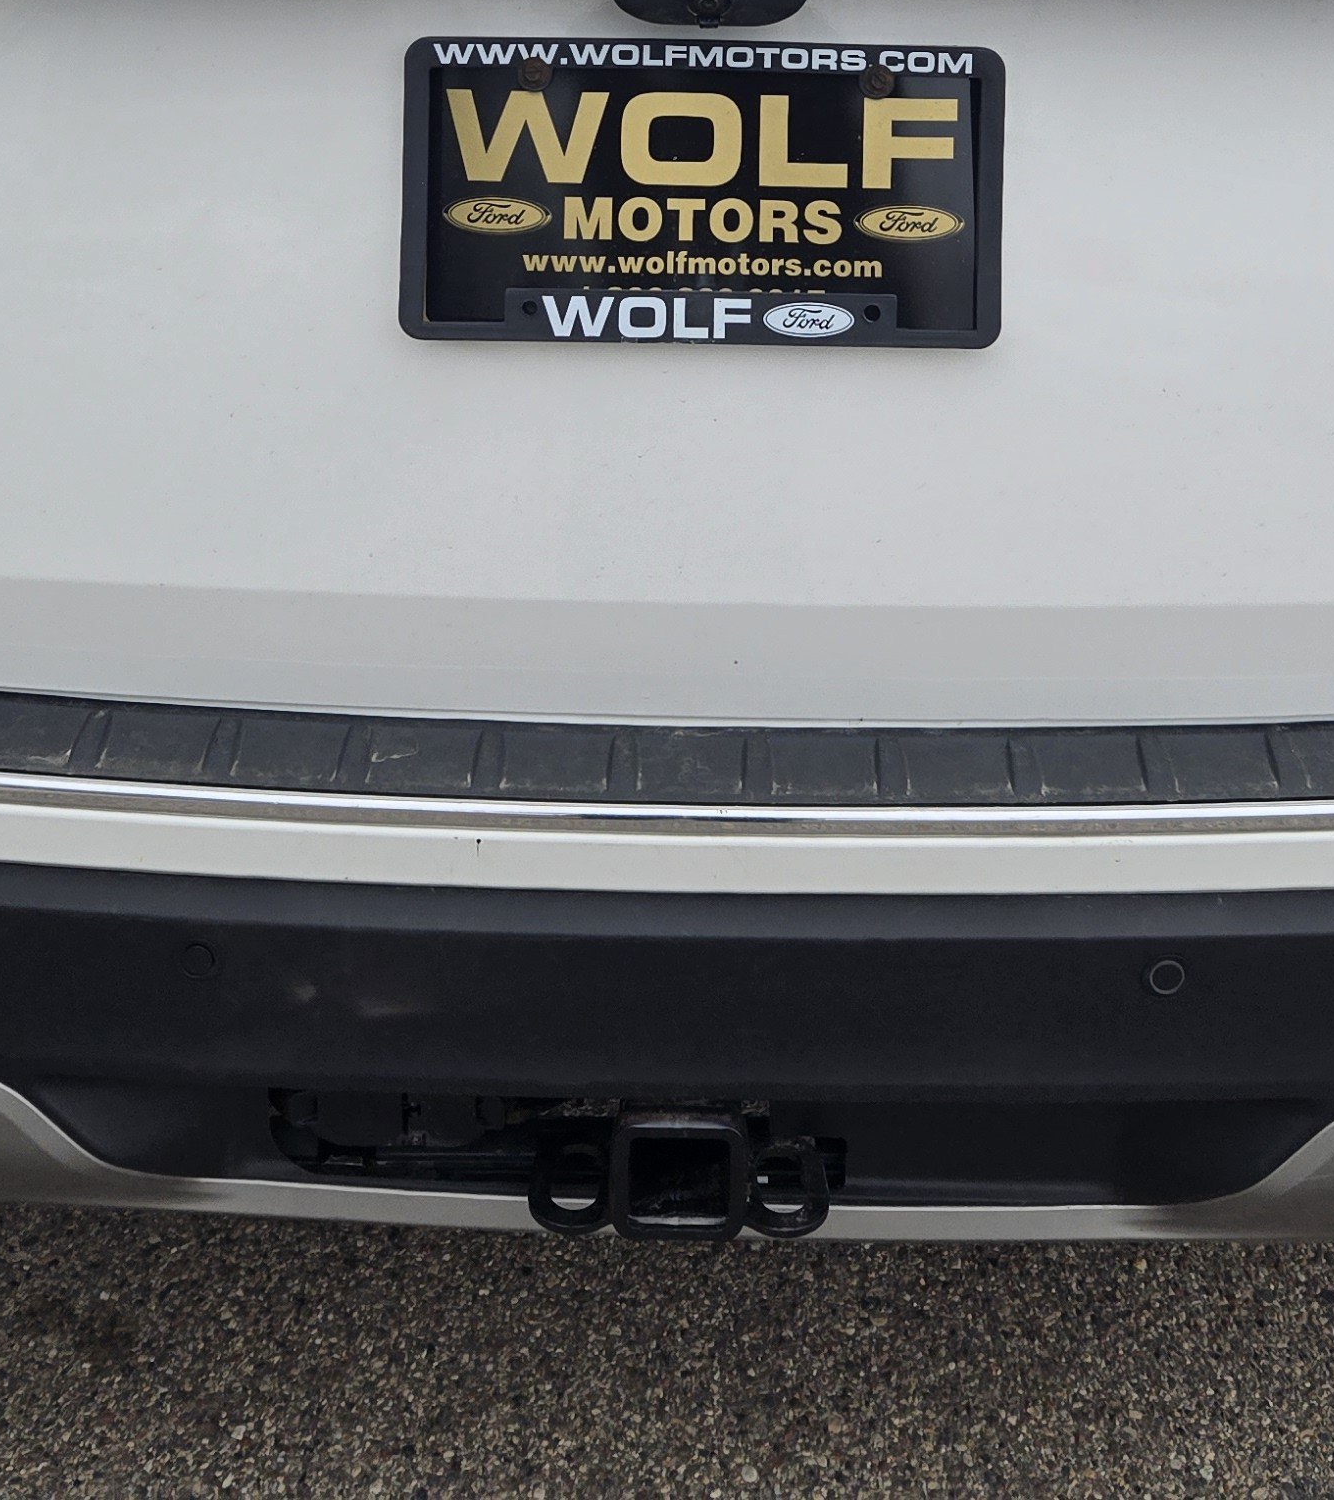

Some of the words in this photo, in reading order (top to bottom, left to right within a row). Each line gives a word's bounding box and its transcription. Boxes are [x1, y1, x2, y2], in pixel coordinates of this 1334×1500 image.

[433, 43, 973, 75] WWW.WOLFMOTORSCOM
[445, 88, 959, 190] WOLF
[467, 202, 526, 226] Ford
[563, 196, 843, 245] MOTORS
[879, 210, 940, 233] Ford
[522, 250, 883, 279] www.wolfmotors.com
[541, 295, 752, 339] WOLF
[782, 308, 836, 330] Ford
